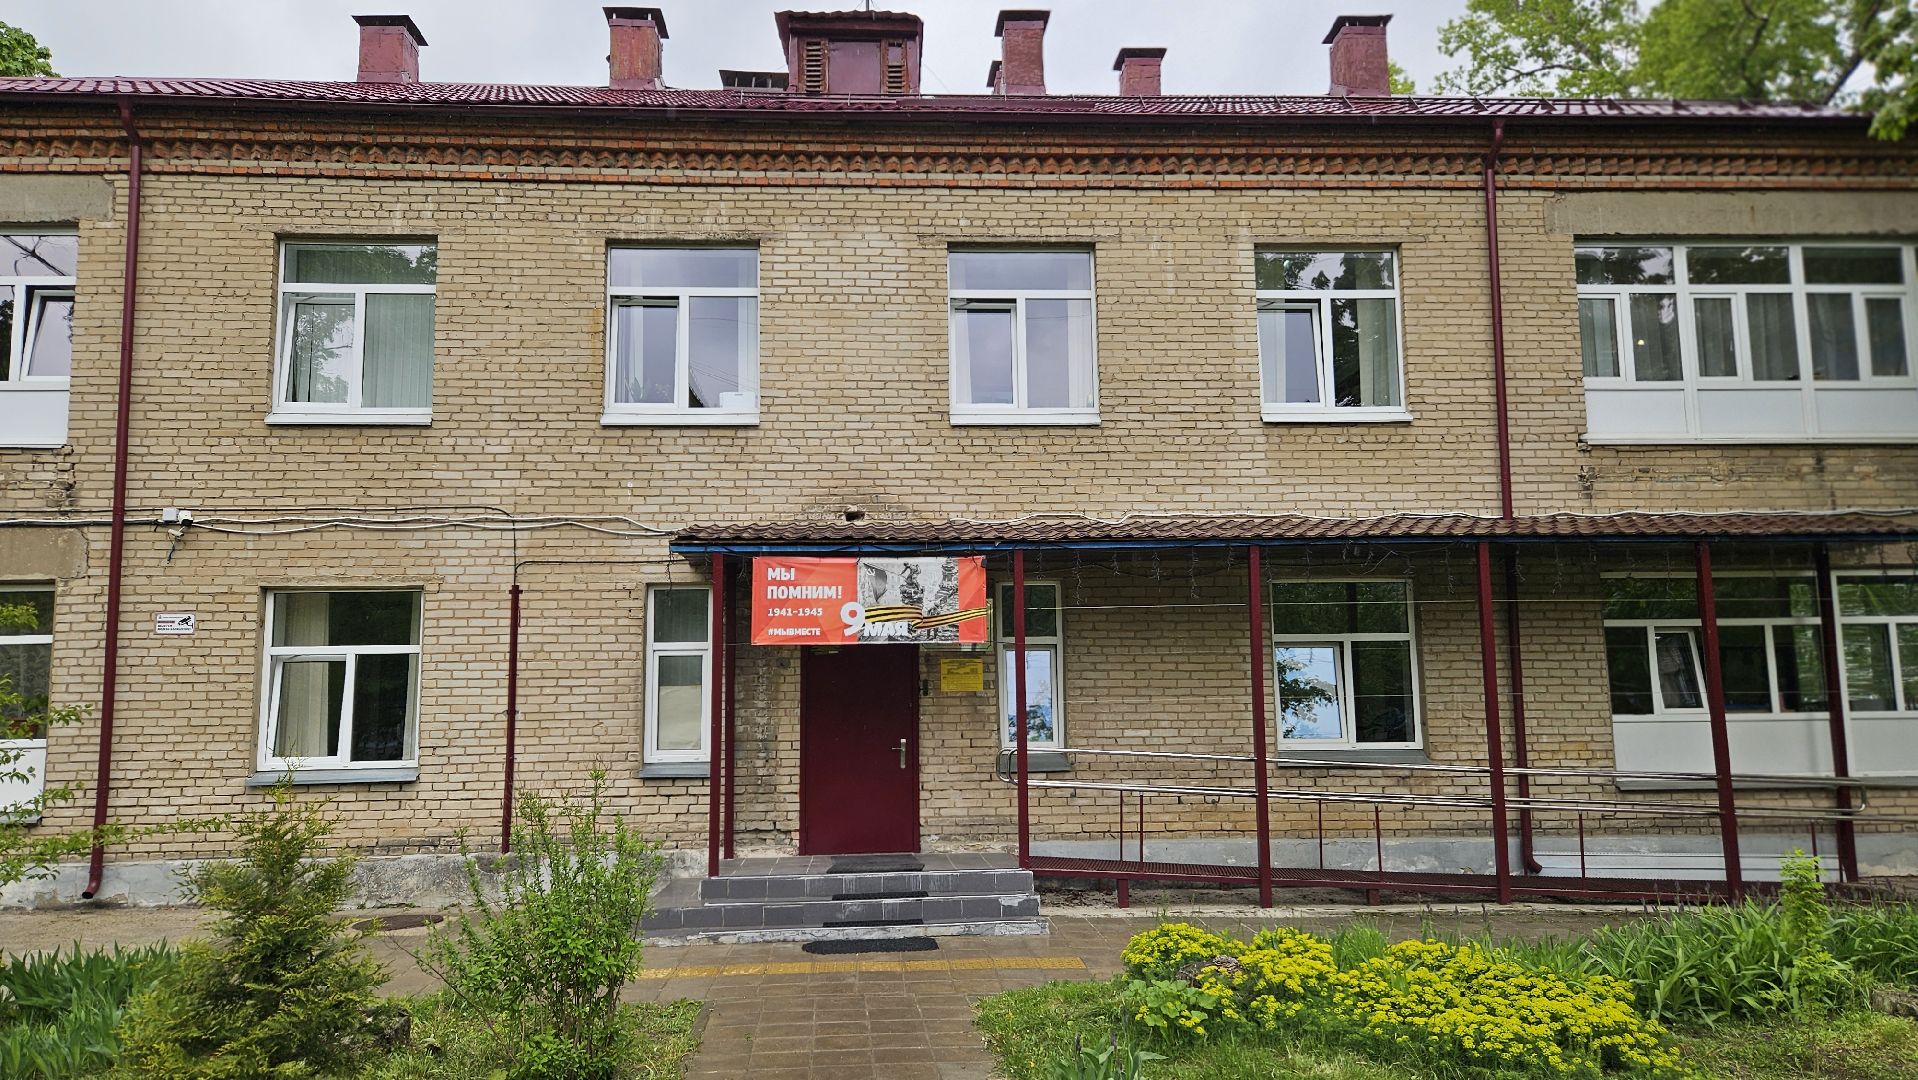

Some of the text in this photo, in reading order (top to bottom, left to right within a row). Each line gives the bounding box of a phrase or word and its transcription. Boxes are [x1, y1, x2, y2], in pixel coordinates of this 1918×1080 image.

[767, 567, 795, 581] МЫ
[767, 586, 842, 599] ПОМНИМ!
[767, 607, 823, 617] 1941-1945
[840, 601, 908, 637] 9 МАЯ
[768, 627, 821, 636] #МЫВМЕСТЕ
